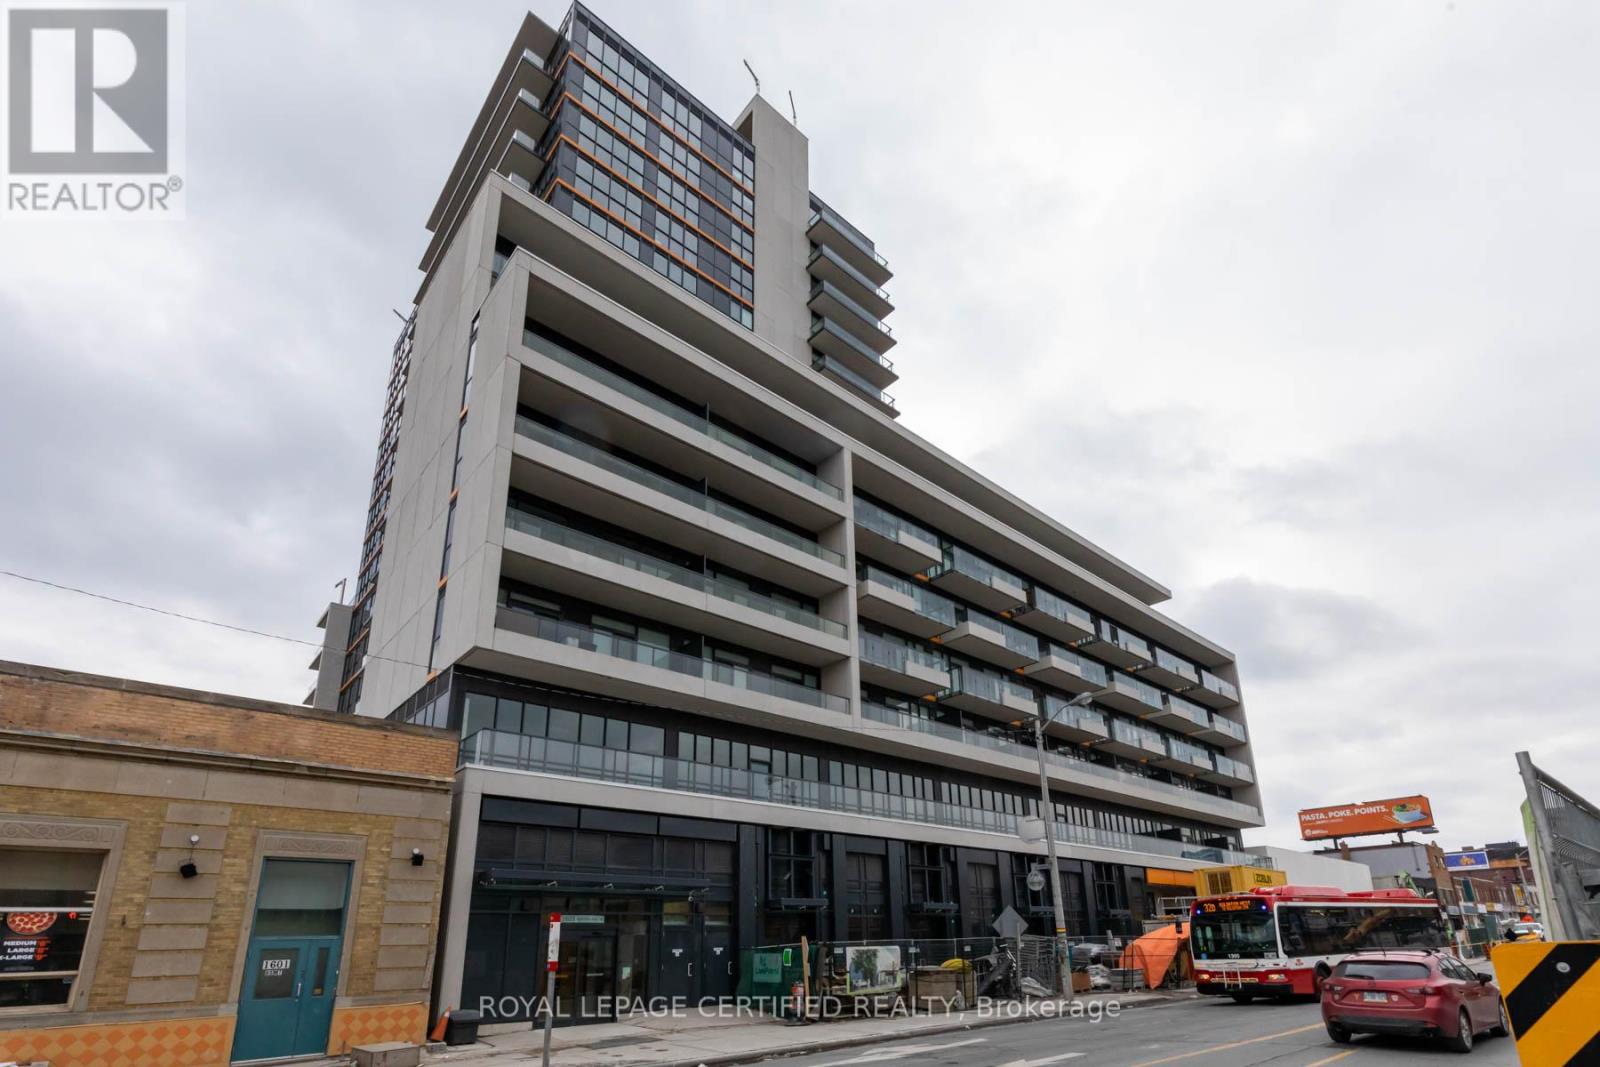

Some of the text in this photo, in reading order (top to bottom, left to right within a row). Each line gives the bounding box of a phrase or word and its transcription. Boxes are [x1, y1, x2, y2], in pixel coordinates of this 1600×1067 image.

[1301, 805, 1389, 821] PASTA. POKE. POINTS.
[264, 960, 289, 969] 1601
